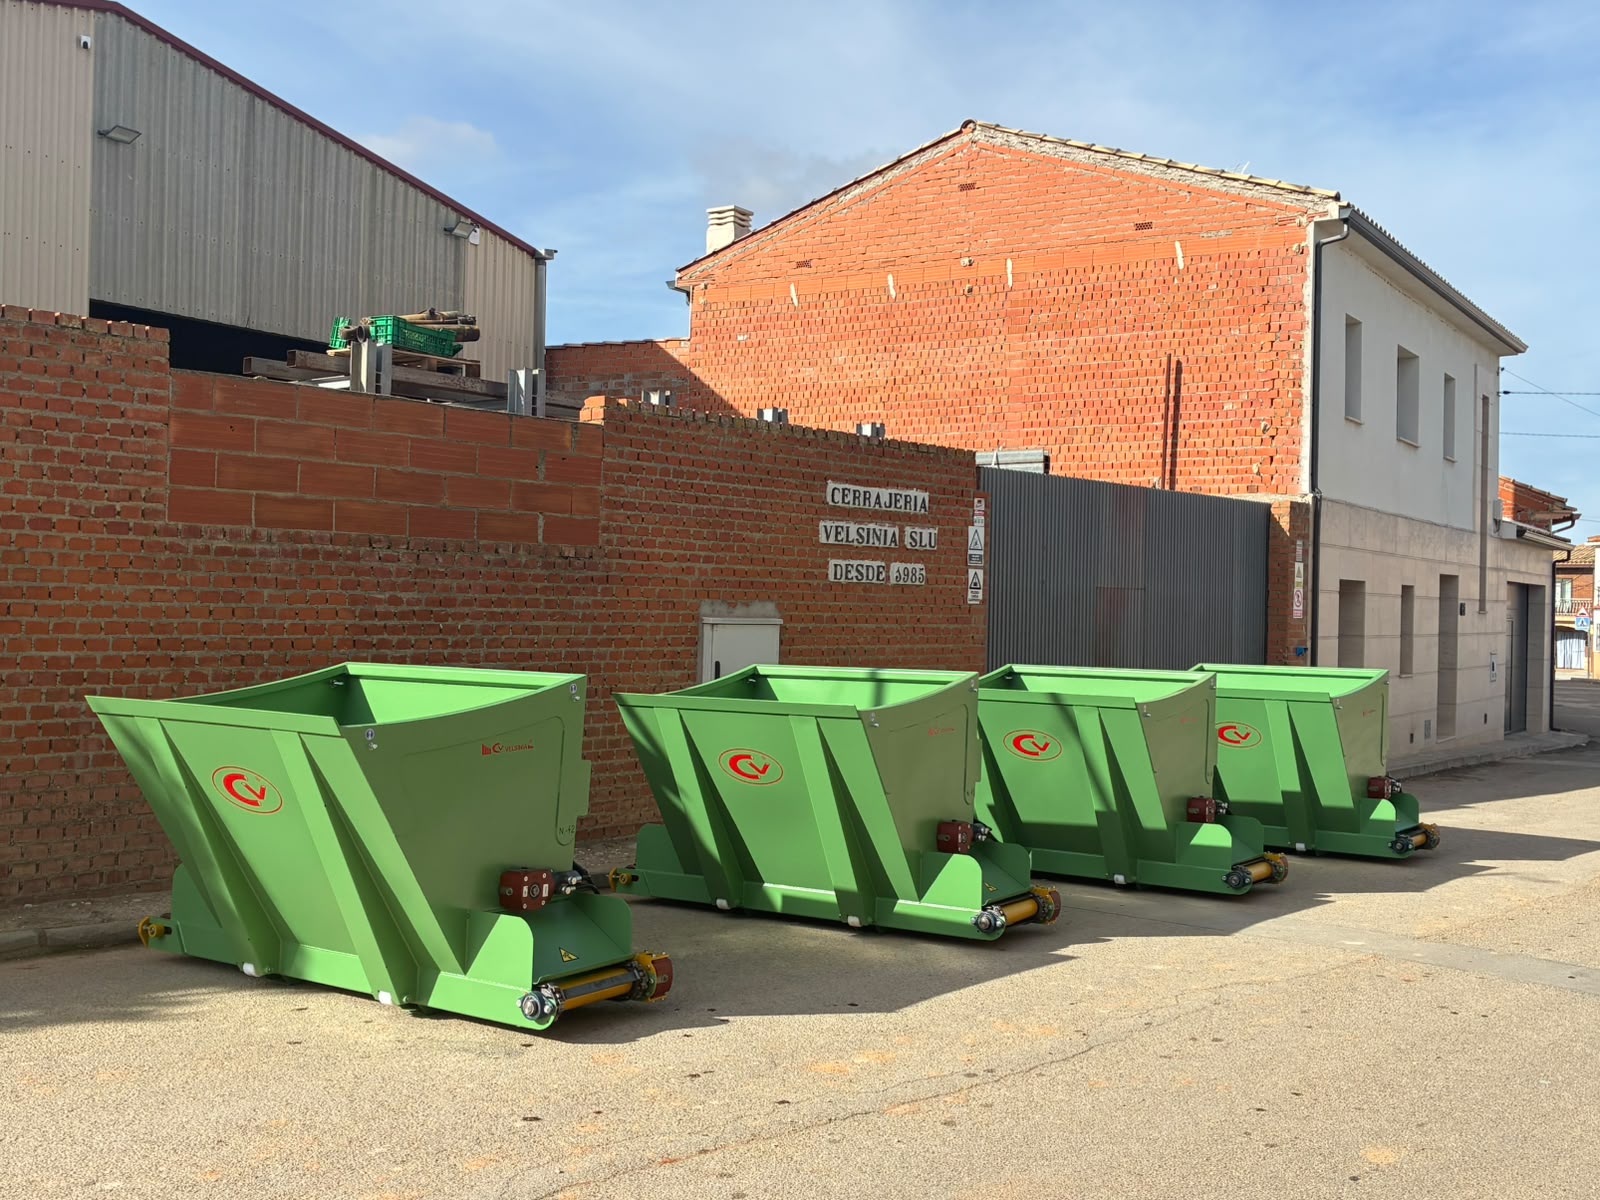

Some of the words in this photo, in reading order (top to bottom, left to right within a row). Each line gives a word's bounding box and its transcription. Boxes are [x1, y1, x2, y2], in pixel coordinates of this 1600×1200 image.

[831, 487, 928, 512] CERRAJERIA
[823, 525, 898, 547] VELSINIA
[909, 530, 937, 549] SLU
[833, 563, 886, 582] DESDE
